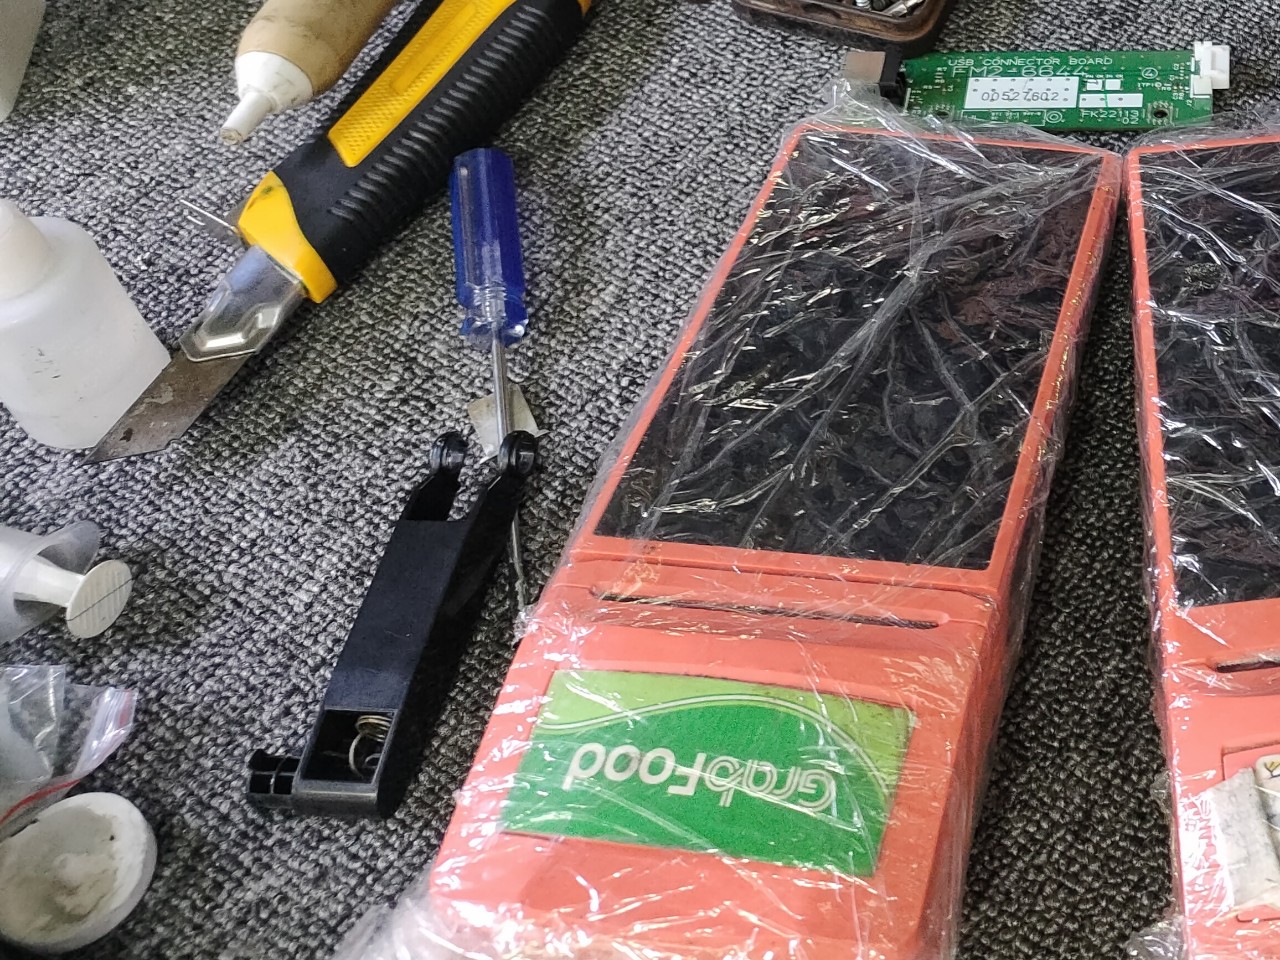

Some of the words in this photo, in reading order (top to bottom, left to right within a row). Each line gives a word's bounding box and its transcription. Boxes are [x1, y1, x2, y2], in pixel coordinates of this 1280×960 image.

[947, 58, 975, 67] USB
[983, 57, 1061, 67] CONNECTOR
[1069, 57, 1113, 66] BOARD
[981, 91, 1060, 102] 00527602
[1081, 109, 1140, 118] FK22113
[562, 742, 837, 813] GrabFood
